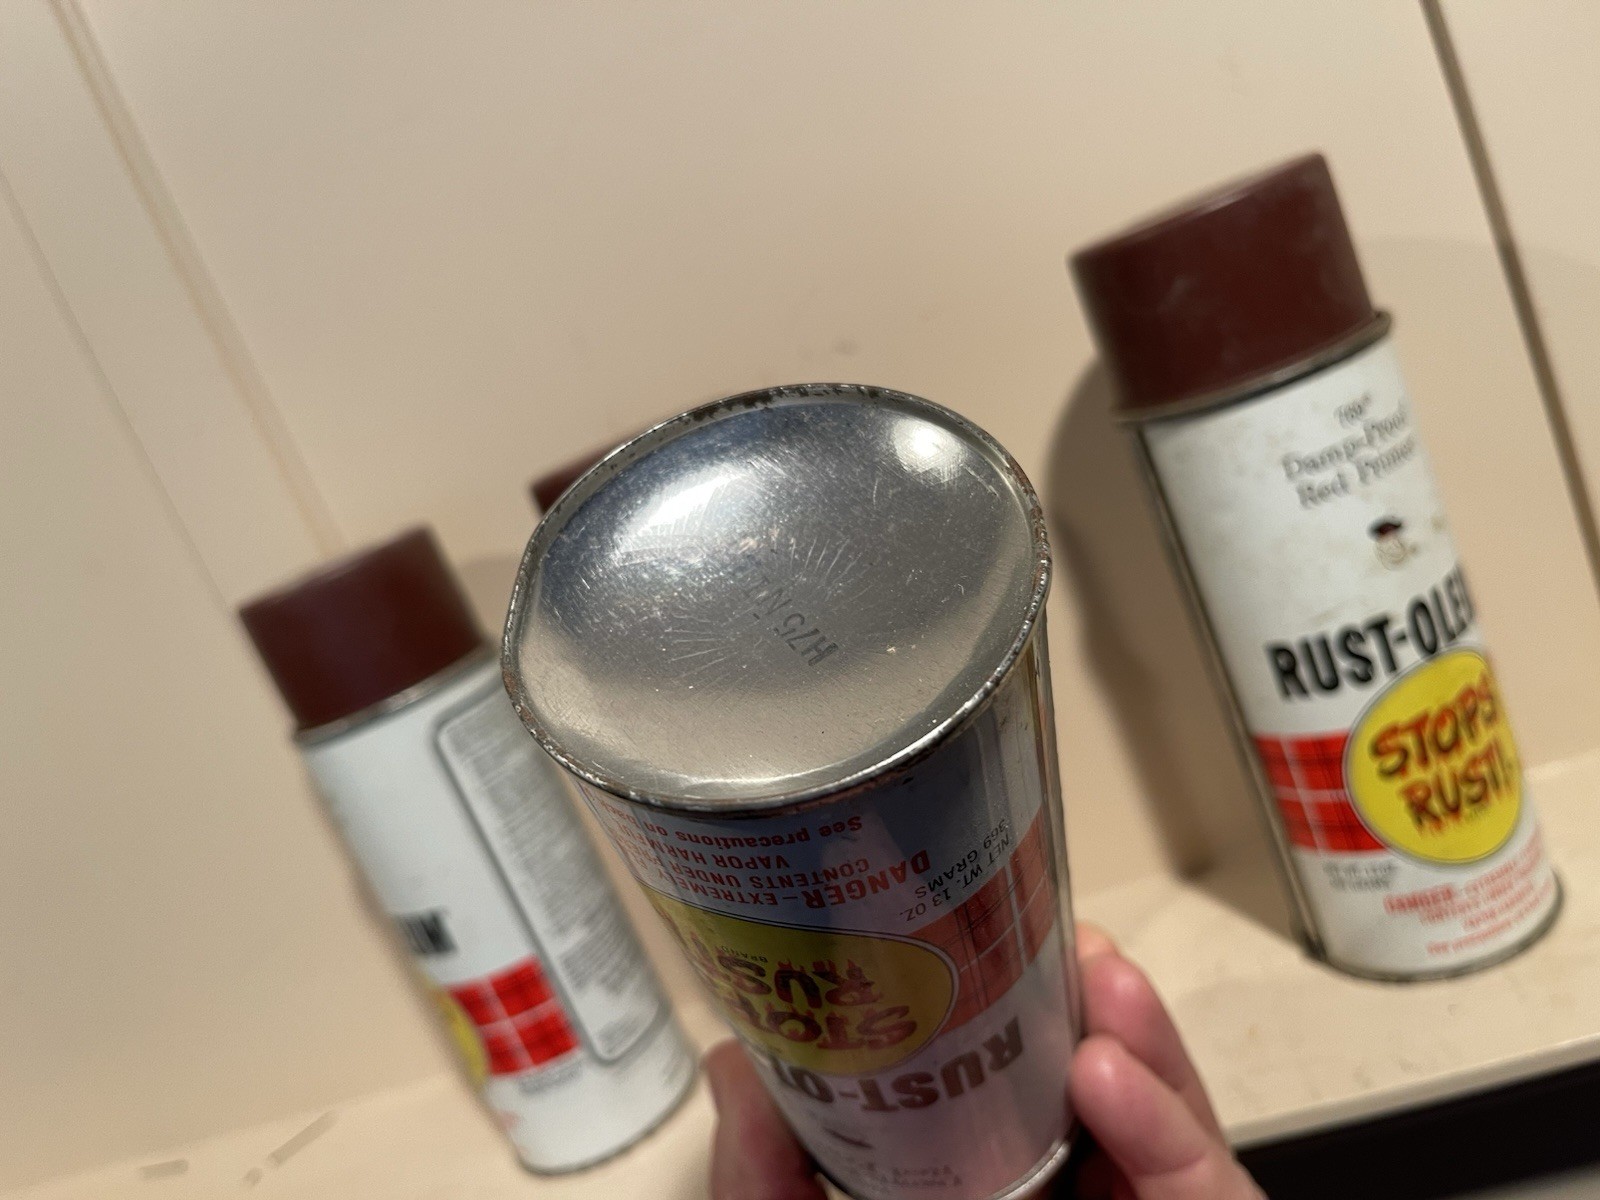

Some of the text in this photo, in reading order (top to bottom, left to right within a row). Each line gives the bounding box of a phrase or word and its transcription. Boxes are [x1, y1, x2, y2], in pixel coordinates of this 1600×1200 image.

[1265, 566, 1476, 702] RUST-OLE
[643, 820, 669, 837] on
[674, 826, 811, 850] precautions
[817, 815, 863, 838] See
[711, 853, 790, 871] VAPOR
[914, 818, 1006, 899] 369 GRAMS
[987, 833, 1010, 867] NET
[668, 860, 742, 889] UNDER
[751, 857, 870, 890] CONTENTS
[932, 888, 951, 908] 13
